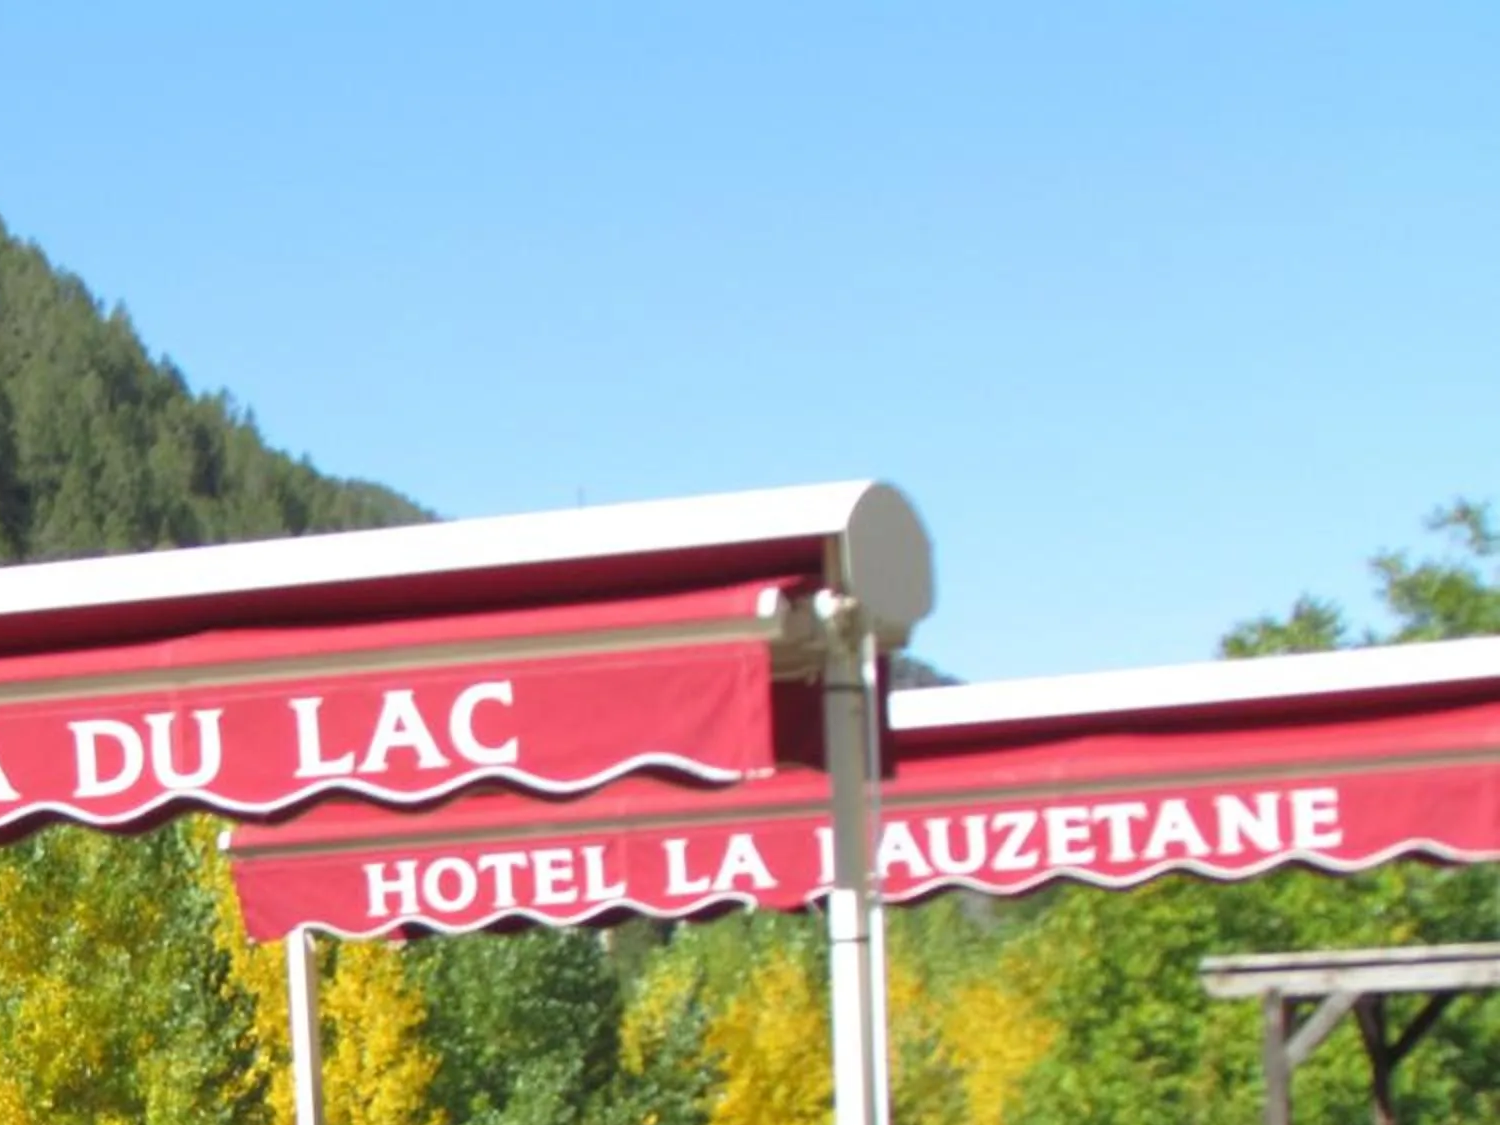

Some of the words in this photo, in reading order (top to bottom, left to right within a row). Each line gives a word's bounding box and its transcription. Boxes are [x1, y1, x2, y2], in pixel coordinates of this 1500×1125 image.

[68, 709, 224, 796] DU
[289, 681, 519, 778] LAC
[364, 846, 625, 916] HOTEL
[663, 834, 777, 894] LA
